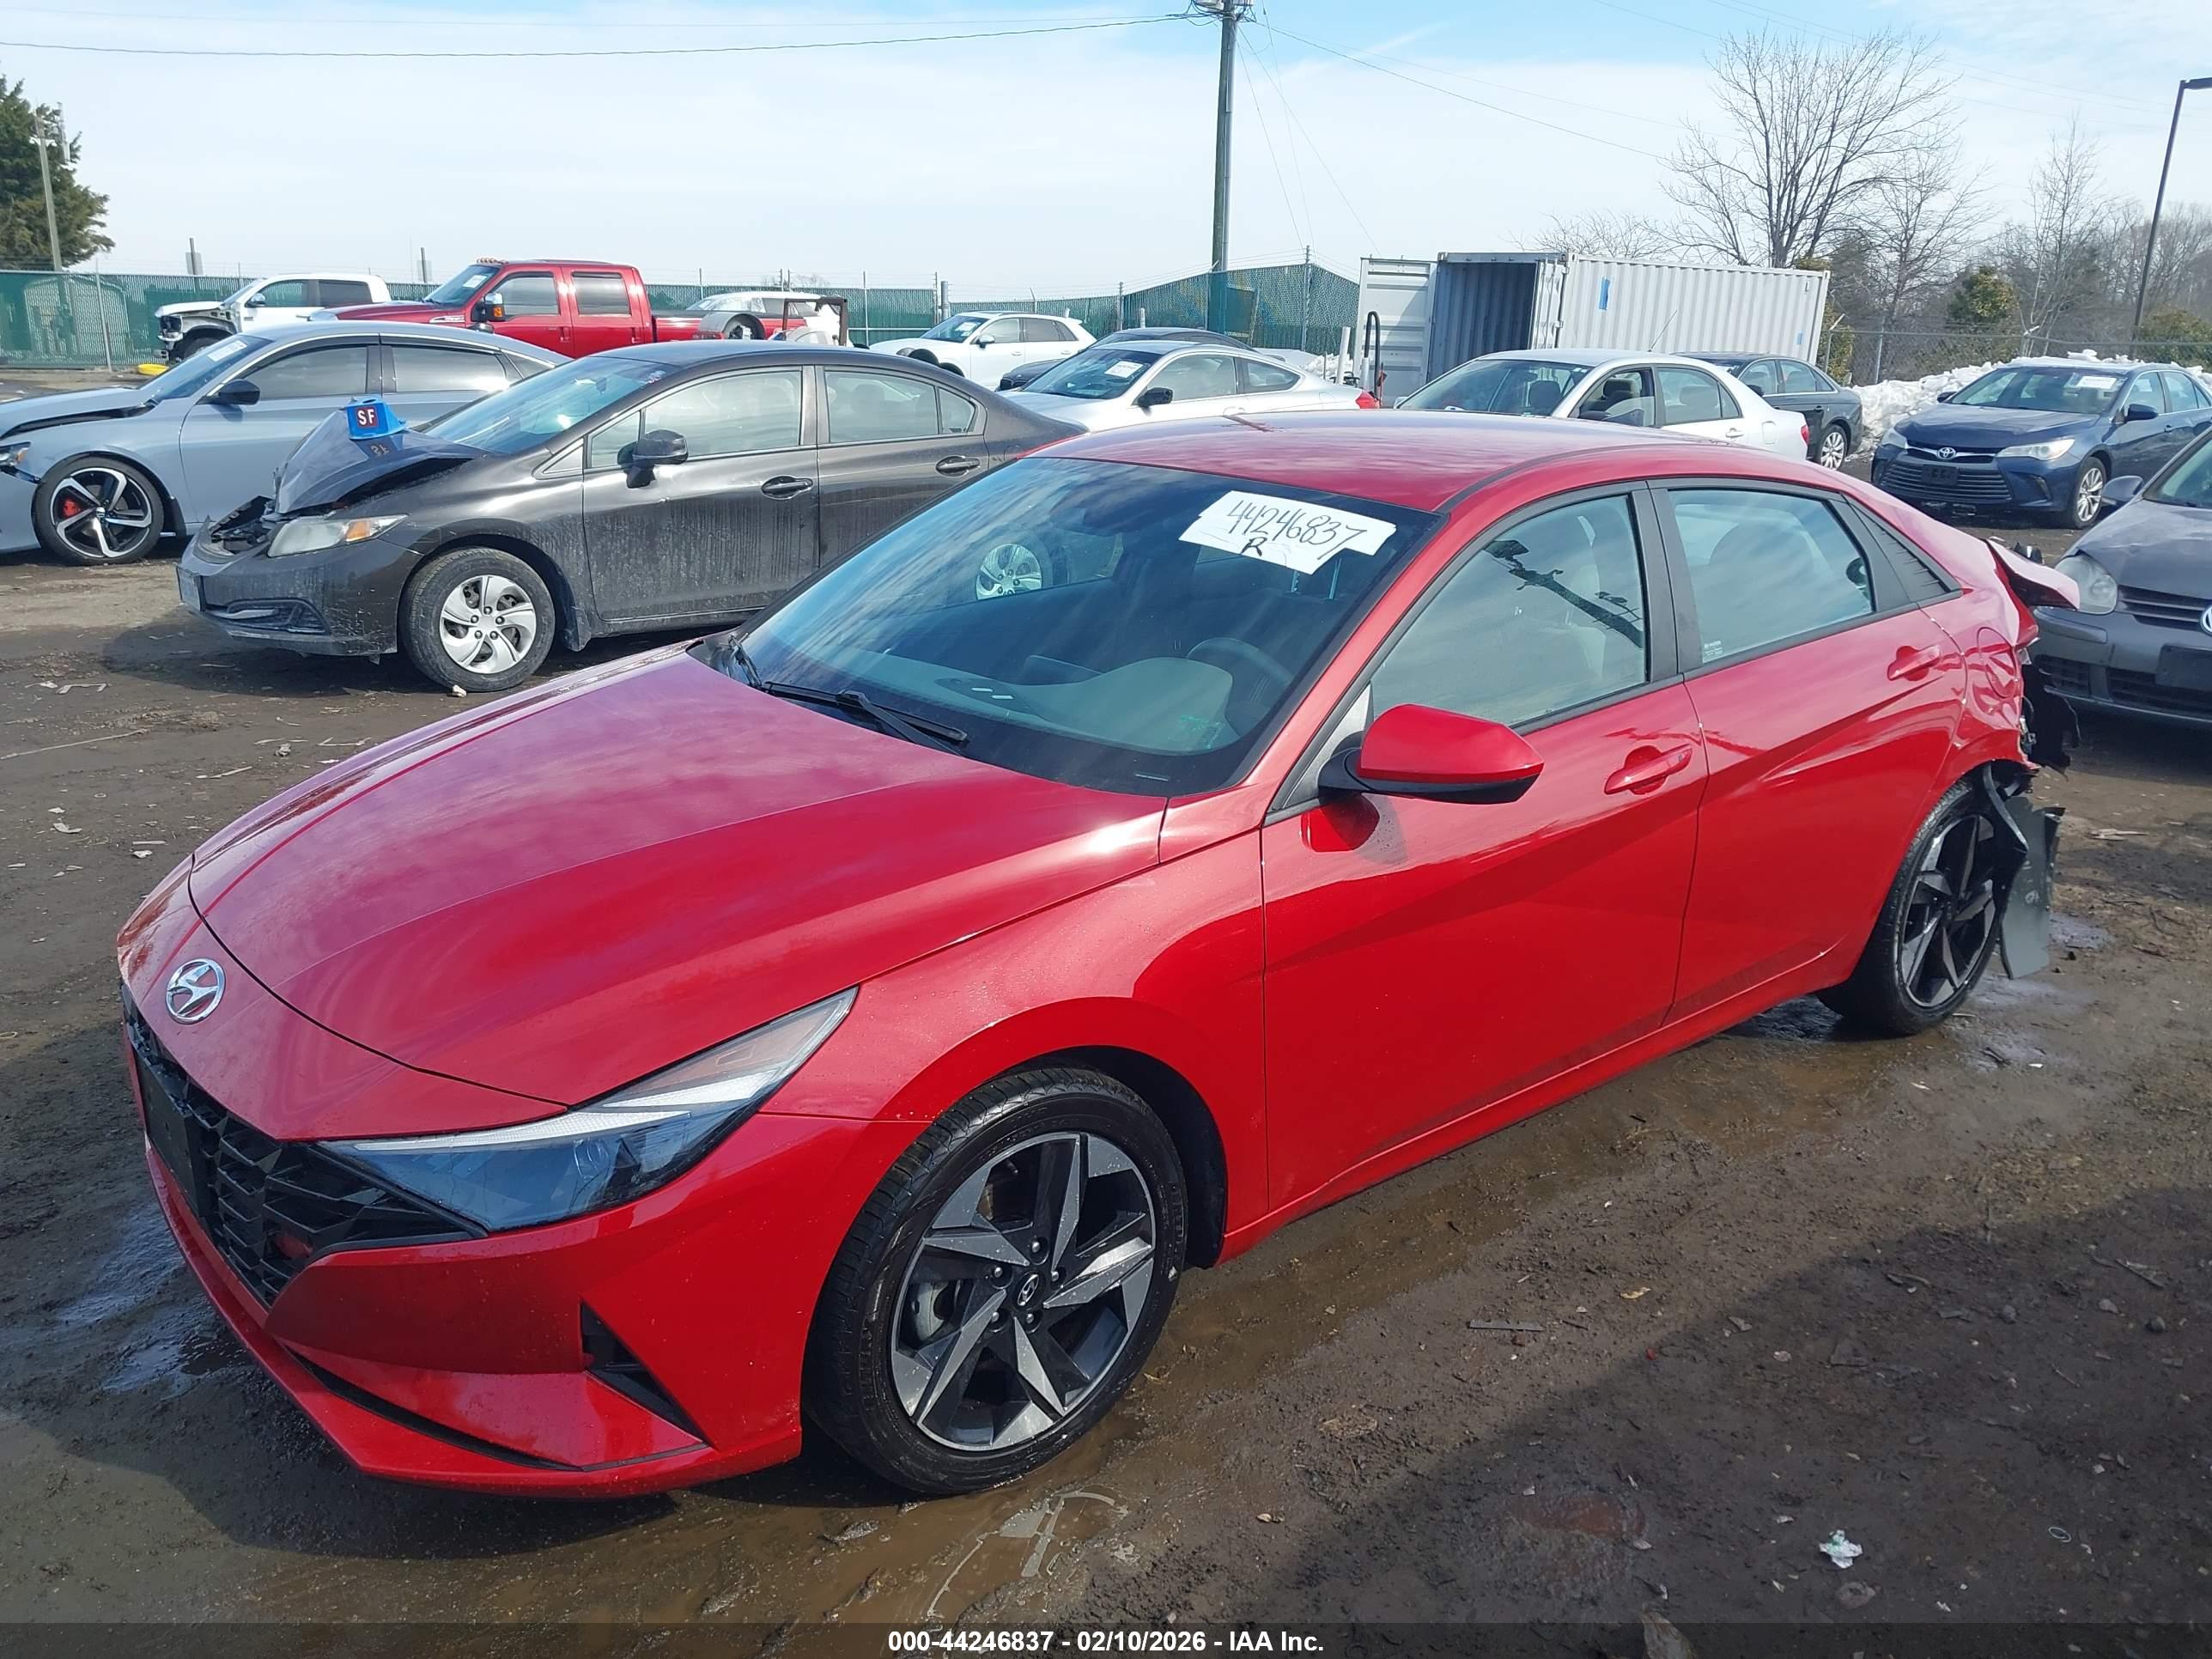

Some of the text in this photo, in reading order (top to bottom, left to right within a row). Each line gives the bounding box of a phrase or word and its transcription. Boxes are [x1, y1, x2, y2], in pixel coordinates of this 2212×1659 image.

[357, 408, 375, 426] SF
[1226, 500, 1368, 561] 44246837
[1241, 536, 1267, 556] R
